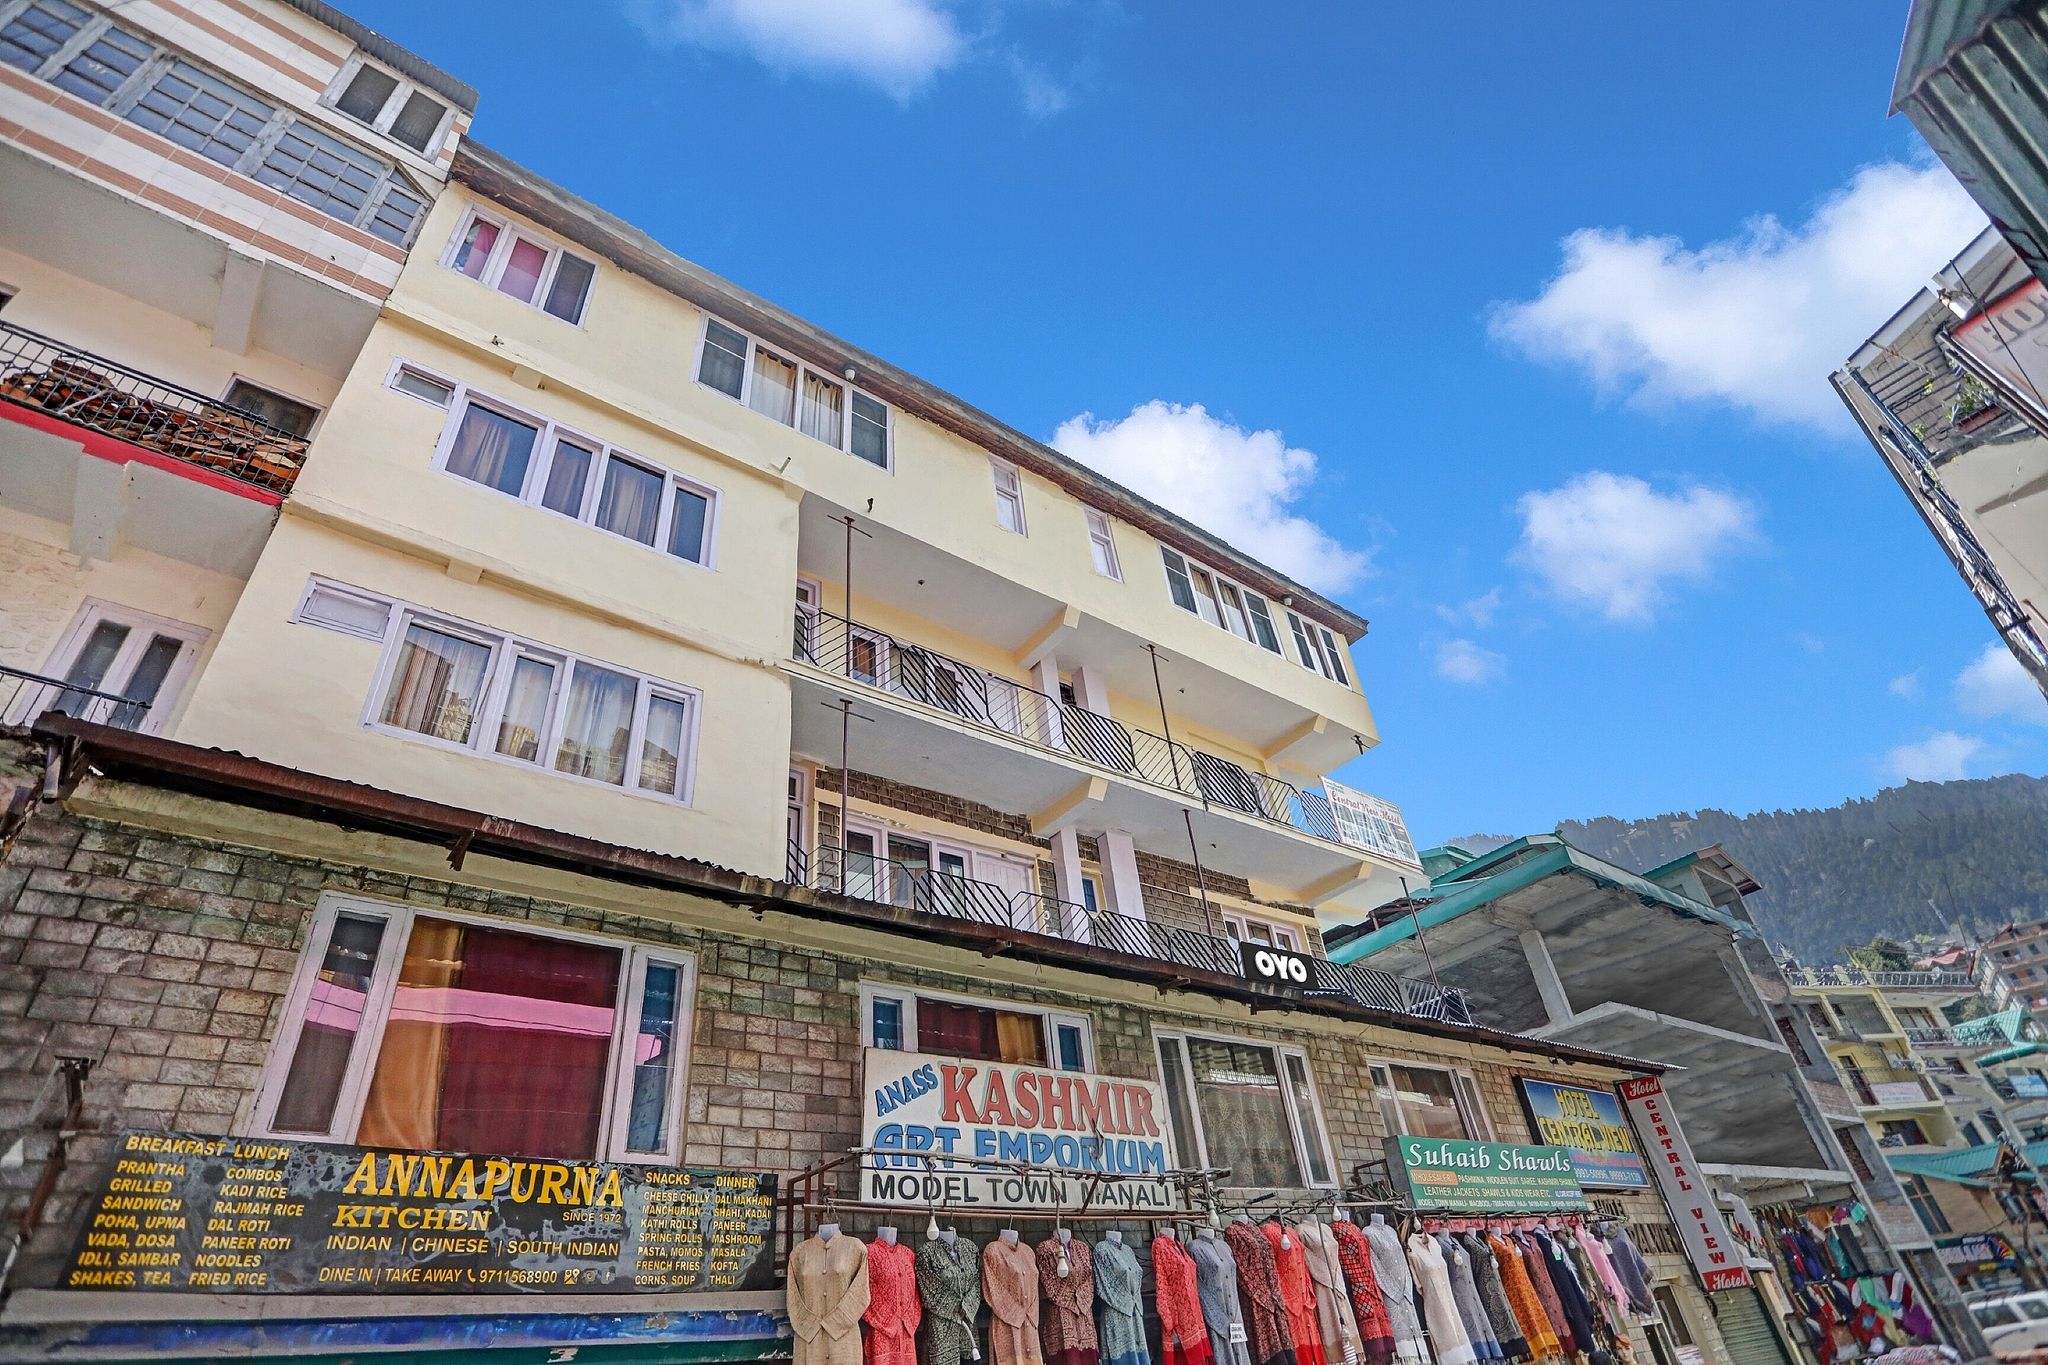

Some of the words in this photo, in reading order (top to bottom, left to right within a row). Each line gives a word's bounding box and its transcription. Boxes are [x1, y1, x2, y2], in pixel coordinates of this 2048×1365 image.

[1254, 949, 1308, 983] OYO
[875, 1063, 939, 1117] ANASS
[1630, 1079, 1659, 1097] Hotel
[940, 1064, 1160, 1137] KASHMIR
[1553, 1088, 1600, 1119] HOTEL
[1538, 1116, 1603, 1152] CENTRAL
[1599, 1124, 1635, 1153] VIEW
[126, 1135, 226, 1157] BREAKFAST
[233, 1144, 290, 1161] LUNCH
[873, 1123, 961, 1170] ART
[974, 1130, 1166, 1175] EMPORIUM
[1406, 1143, 1491, 1169] Suhaib
[1498, 1148, 1571, 1172] Shawls
[116, 1160, 186, 1177] PRANTHA
[226, 1168, 283, 1182] COMBOS
[110, 1177, 173, 1193] GRILLED
[342, 1152, 624, 1207] ANNAPURNA
[645, 1172, 691, 1185] SNACKS
[716, 1176, 757, 1189] DINNER
[1644, 1099, 1692, 1191] CENTRAL
[1690, 1207, 1726, 1264] VIEW
[220, 1184, 254, 1197] KADI
[256, 1186, 288, 1199] RICE
[643, 1191, 678, 1202] CHEESE
[680, 1192, 711, 1203] CHILLY
[871, 1173, 980, 1203] MODEL
[986, 1178, 1068, 1204] TOWN
[1080, 1180, 1171, 1207] MANALI
[1423, 1186, 1452, 1196] LEATHER
[1482, 1188, 1505, 1197] SHAWLS
[101, 1195, 182, 1211] SANDWICH
[714, 1194, 732, 1204] DAL
[733, 1195, 772, 1207] MAKHANI
[214, 1201, 272, 1215] RAJMAH
[273, 1203, 305, 1217] RICE
[642, 1205, 701, 1216] MANCHURIAN
[745, 1208, 771, 1219] KADAI
[94, 1214, 140, 1231] POHA,
[145, 1216, 187, 1230] UPMA
[207, 1218, 234, 1232] DAL
[238, 1219, 271, 1232] ROTI
[332, 1204, 493, 1231] KITCHEN
[562, 1211, 595, 1222] SINCE
[599, 1212, 622, 1224] 1972
[640, 1219, 667, 1229] KATHI
[670, 1219, 698, 1230] ROLLS
[713, 1221, 747, 1231] PANEER
[87, 1232, 130, 1248] VADA,
[135, 1234, 176, 1248] DOSA
[201, 1235, 257, 1249] PANEER
[259, 1237, 291, 1250] ROTI
[326, 1235, 393, 1250] INDIAN
[412, 1237, 489, 1253] CHINESE
[507, 1240, 563, 1254] SOUTH
[567, 1242, 619, 1256] INDIAN
[639, 1232, 673, 1243] SPRING
[675, 1233, 703, 1244] ROLLS
[711, 1234, 762, 1245] MASHROOM
[78, 1251, 113, 1267] IDLI,
[117, 1252, 182, 1266] SAMBAR
[638, 1246, 668, 1258] PASTA,
[670, 1247, 704, 1257] MOMOS
[711, 1247, 747, 1257] MASALA
[195, 1254, 262, 1268] NOODLES
[636, 1260, 673, 1271] FRENCH
[675, 1261, 701, 1271] FRIES
[710, 1261, 739, 1271] KOFTA
[69, 1270, 137, 1286] SHAKES,
[143, 1271, 172, 1285] TEA
[188, 1272, 231, 1285] FRIED
[234, 1272, 268, 1286] RICE
[319, 1267, 355, 1282] DINE
[358, 1268, 373, 1282] IN
[385, 1268, 421, 1282] TAKE
[423, 1268, 464, 1283] AWAY
[479, 1269, 558, 1284] 9711568900
[671, 1274, 696, 1285] SOUP
[710, 1275, 736, 1285] THALI
[1712, 1271, 1747, 1290] Hotel
